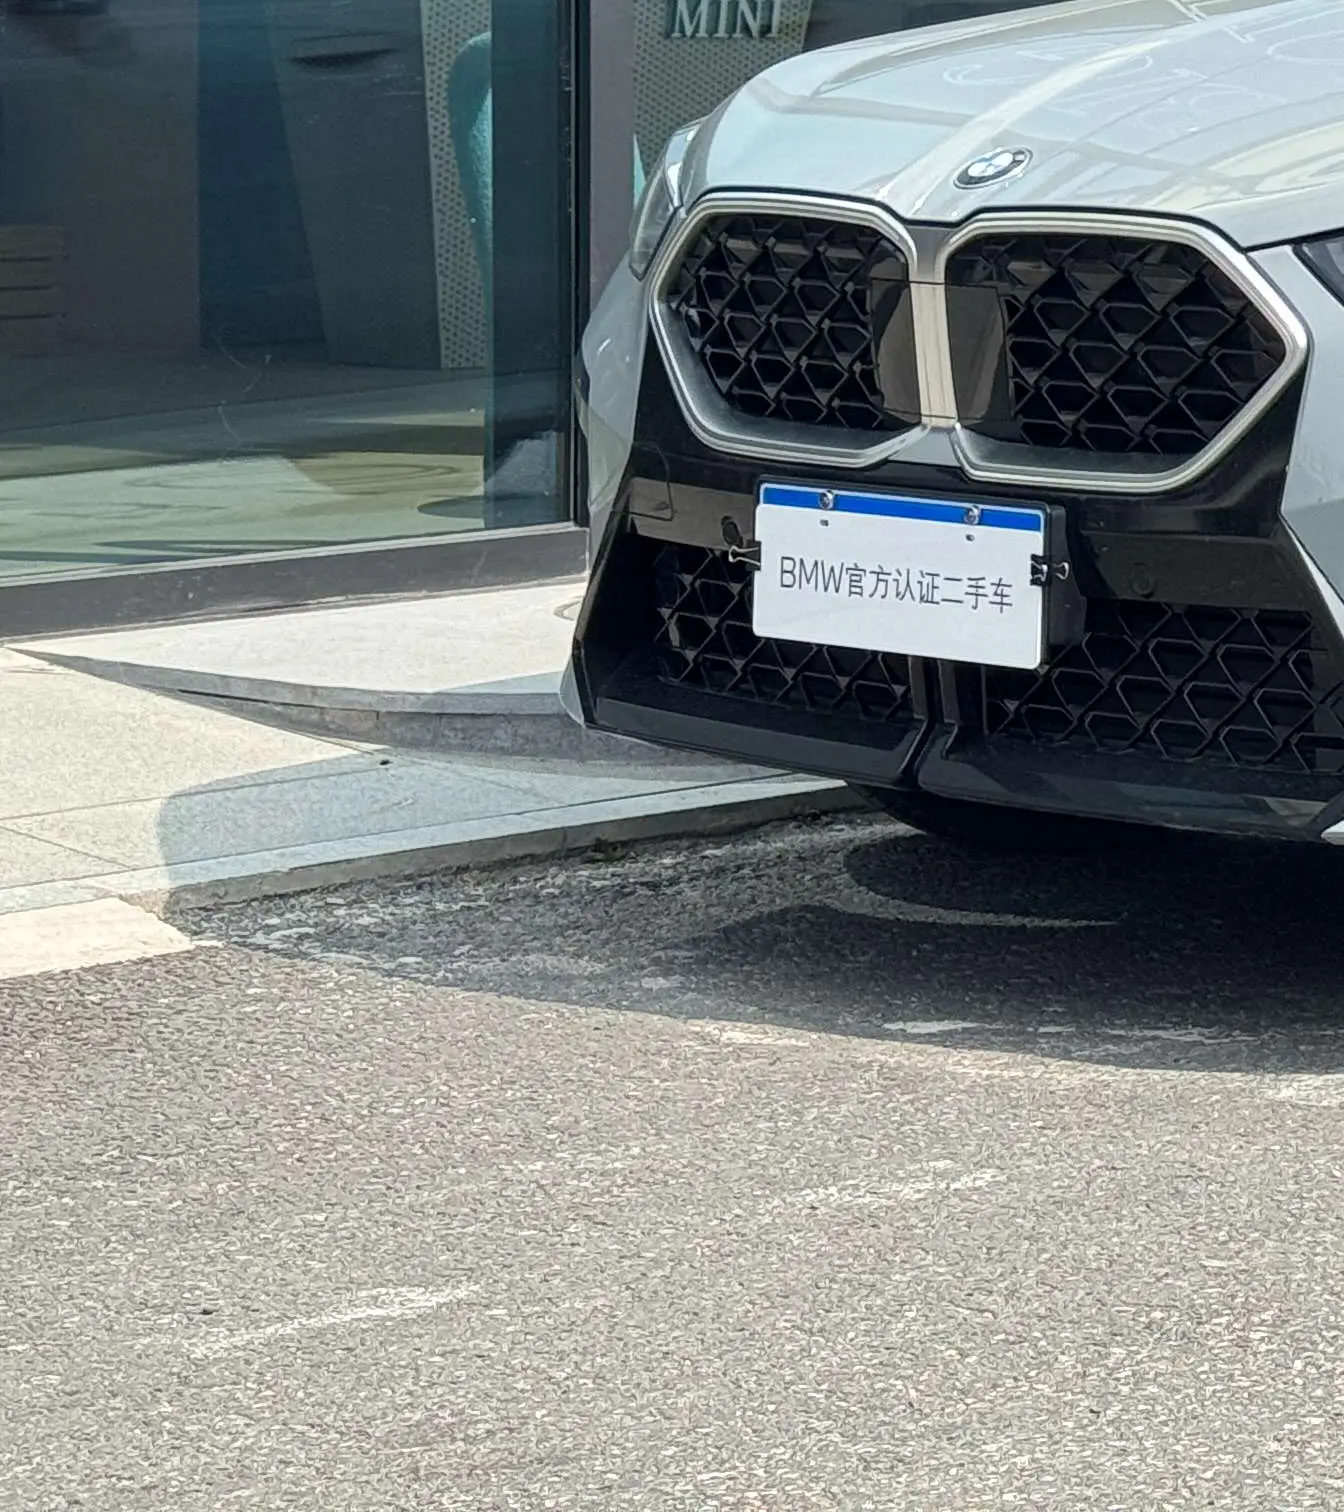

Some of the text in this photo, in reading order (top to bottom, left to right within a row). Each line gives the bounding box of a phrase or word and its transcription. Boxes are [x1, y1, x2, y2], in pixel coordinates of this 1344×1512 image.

[779, 555, 1014, 614] BMW官方认证二手车
